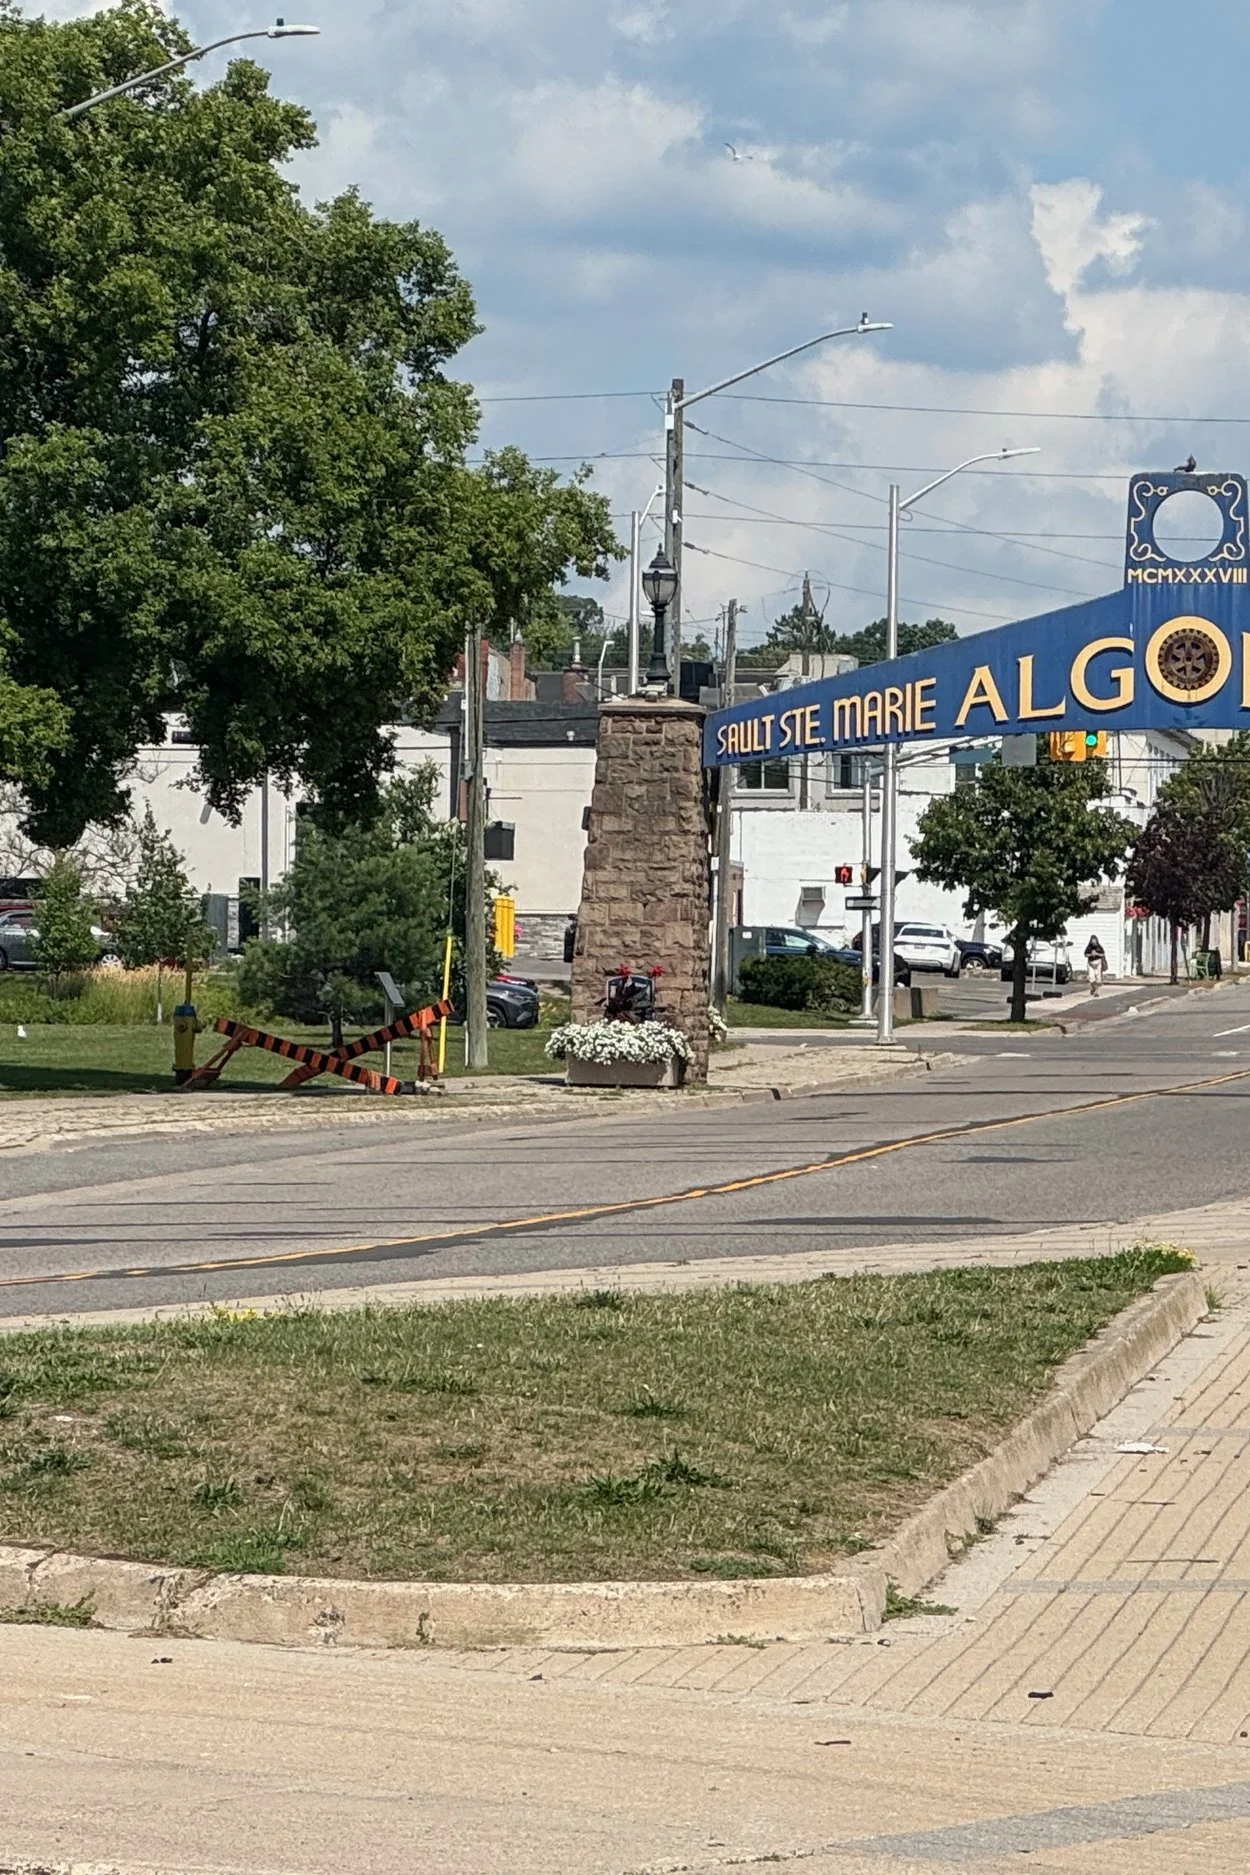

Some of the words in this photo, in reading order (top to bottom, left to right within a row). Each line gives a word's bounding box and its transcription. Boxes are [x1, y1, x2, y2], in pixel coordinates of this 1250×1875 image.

[1127, 567, 1248, 584] MCMXXXVIII
[717, 714, 775, 756] SAULT
[779, 703, 826, 748] STE.
[834, 677, 937, 741] MARIE
